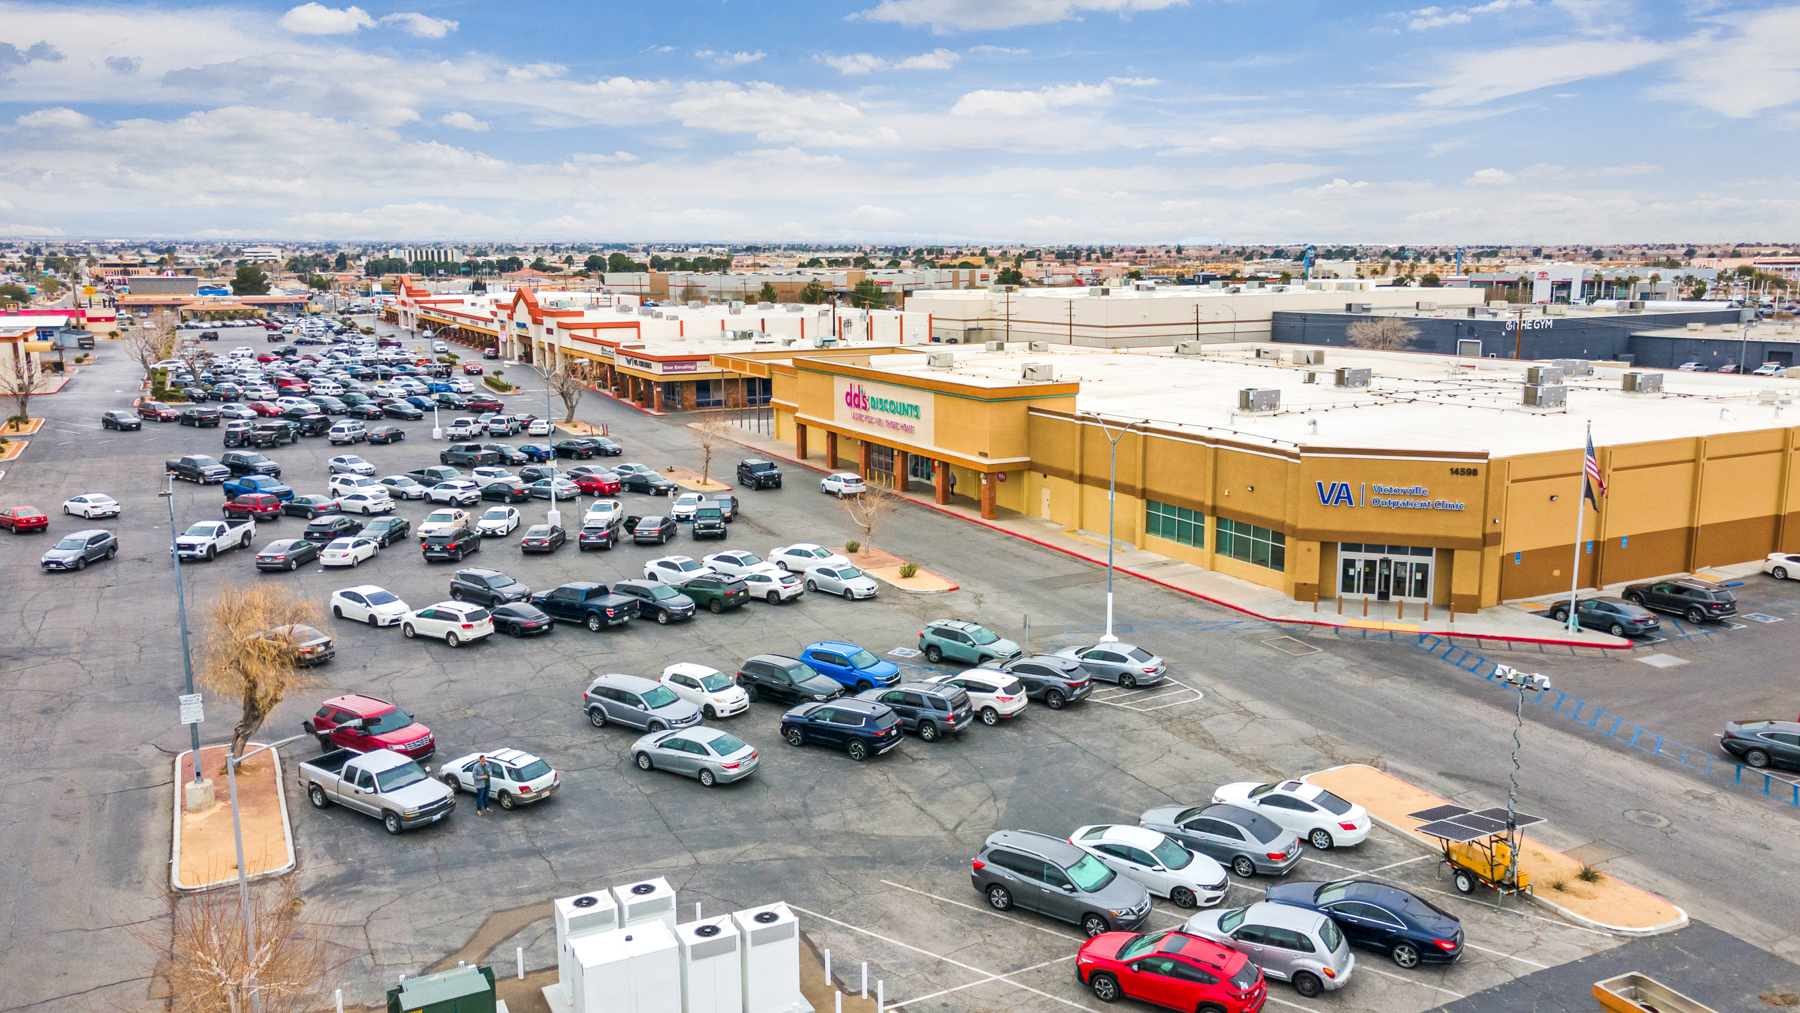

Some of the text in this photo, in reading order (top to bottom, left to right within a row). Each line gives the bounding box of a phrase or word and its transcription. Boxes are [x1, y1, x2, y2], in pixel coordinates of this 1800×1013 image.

[1533, 319, 1553, 329] GYM
[845, 383, 920, 419] dd's DISCOUNTS
[1449, 467, 1478, 476] 14598
[1315, 480, 1355, 507] VA
[1372, 484, 1428, 496] Victorville
[1371, 497, 1465, 511] Outpatient Clinic
